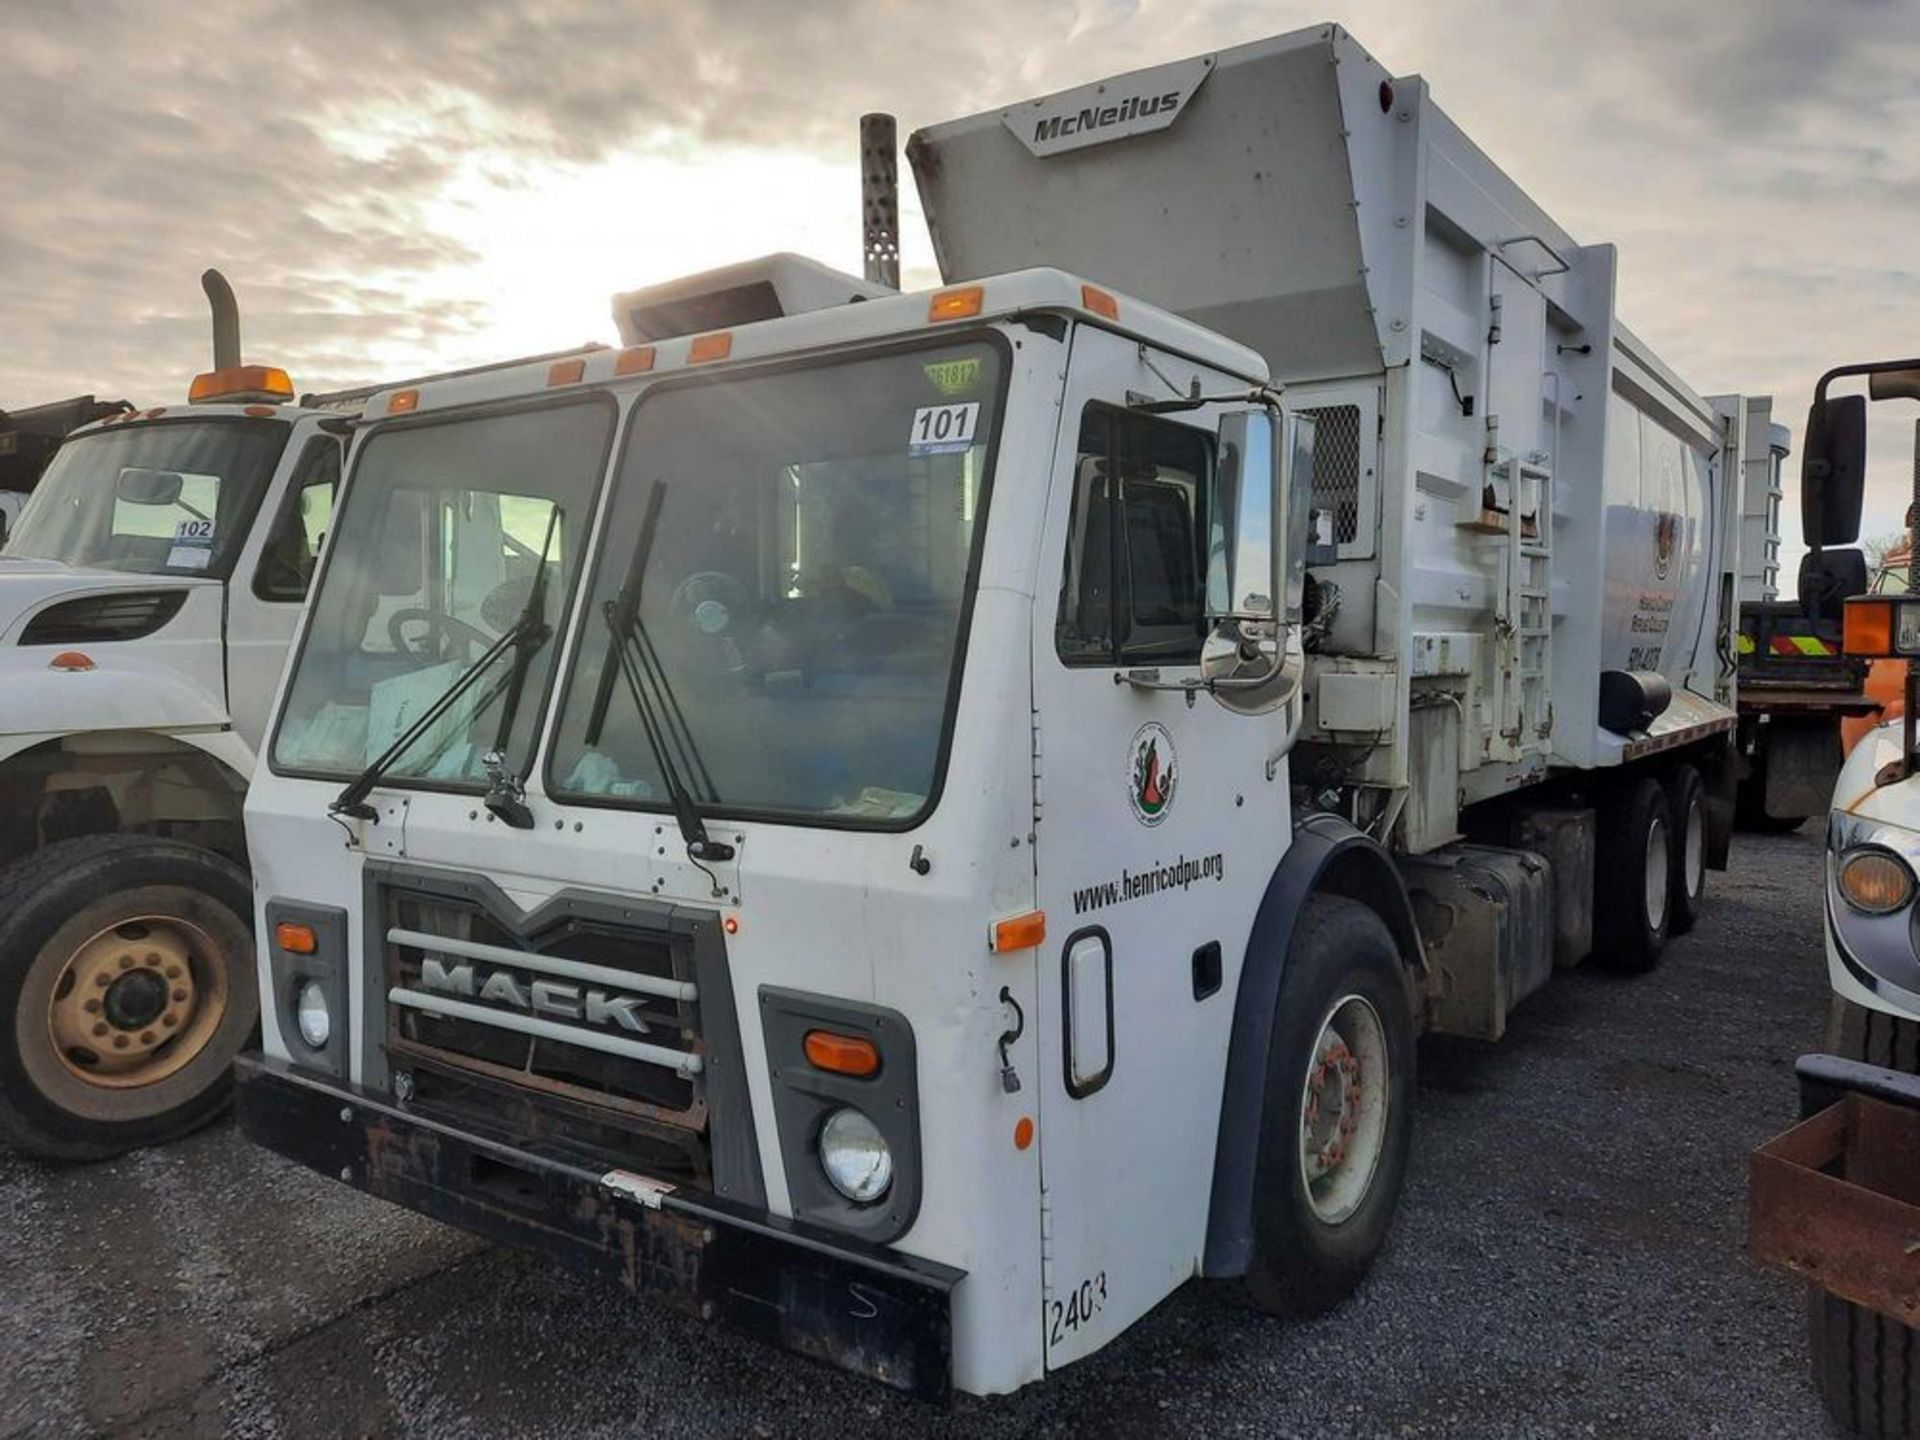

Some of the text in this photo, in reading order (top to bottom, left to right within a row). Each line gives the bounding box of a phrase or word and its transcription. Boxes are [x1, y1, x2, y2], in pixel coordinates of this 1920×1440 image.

[1034, 92, 1180, 142] McNeilus
[919, 406, 969, 441] 101
[180, 521, 211, 537] 102
[1073, 853, 1223, 915] www.henricodpu.org
[421, 957, 650, 1034] MACK
